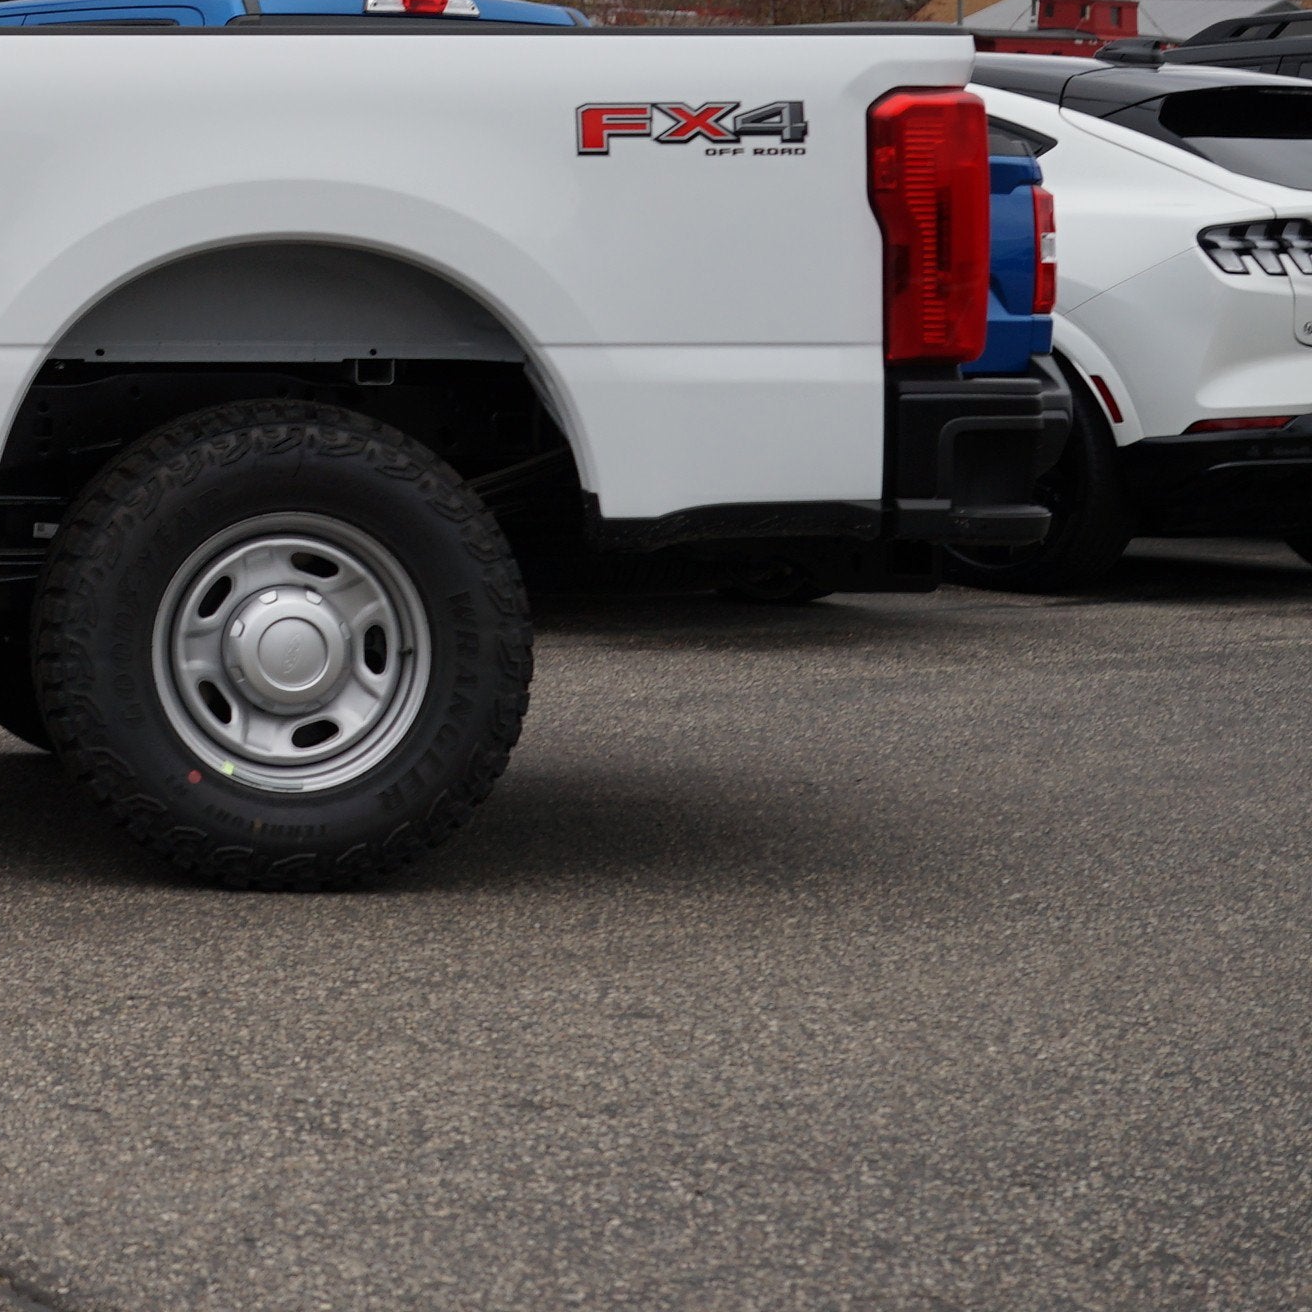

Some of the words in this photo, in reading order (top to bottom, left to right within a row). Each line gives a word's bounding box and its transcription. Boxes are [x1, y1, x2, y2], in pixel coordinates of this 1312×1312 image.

[576, 101, 807, 156] FX4
[705, 147, 744, 156] OFF
[753, 147, 806, 156] ROAD
[379, 591, 484, 814] WRANGLER
